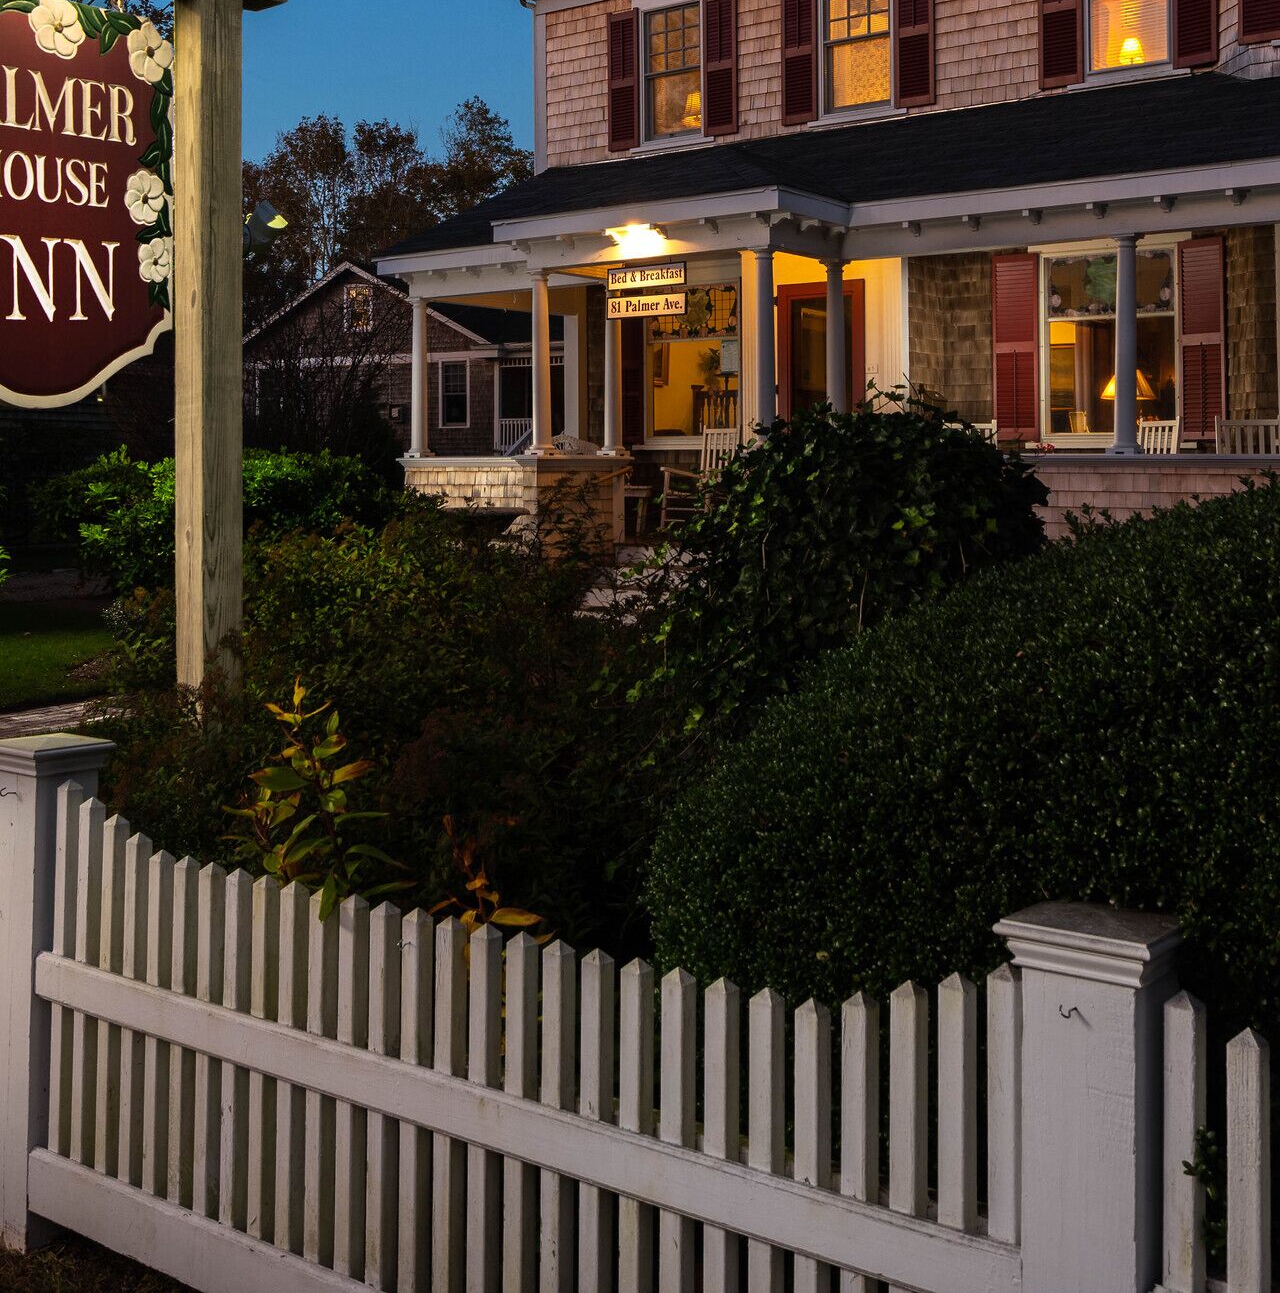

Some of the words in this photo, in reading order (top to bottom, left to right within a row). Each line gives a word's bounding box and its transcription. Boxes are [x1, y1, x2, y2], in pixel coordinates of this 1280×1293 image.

[611, 272, 627, 285] Bed
[630, 270, 637, 283] &
[640, 268, 683, 282] Breakfast
[611, 301, 621, 314] 81
[625, 300, 660, 313] Palmer
[663, 297, 683, 311] Ave.
